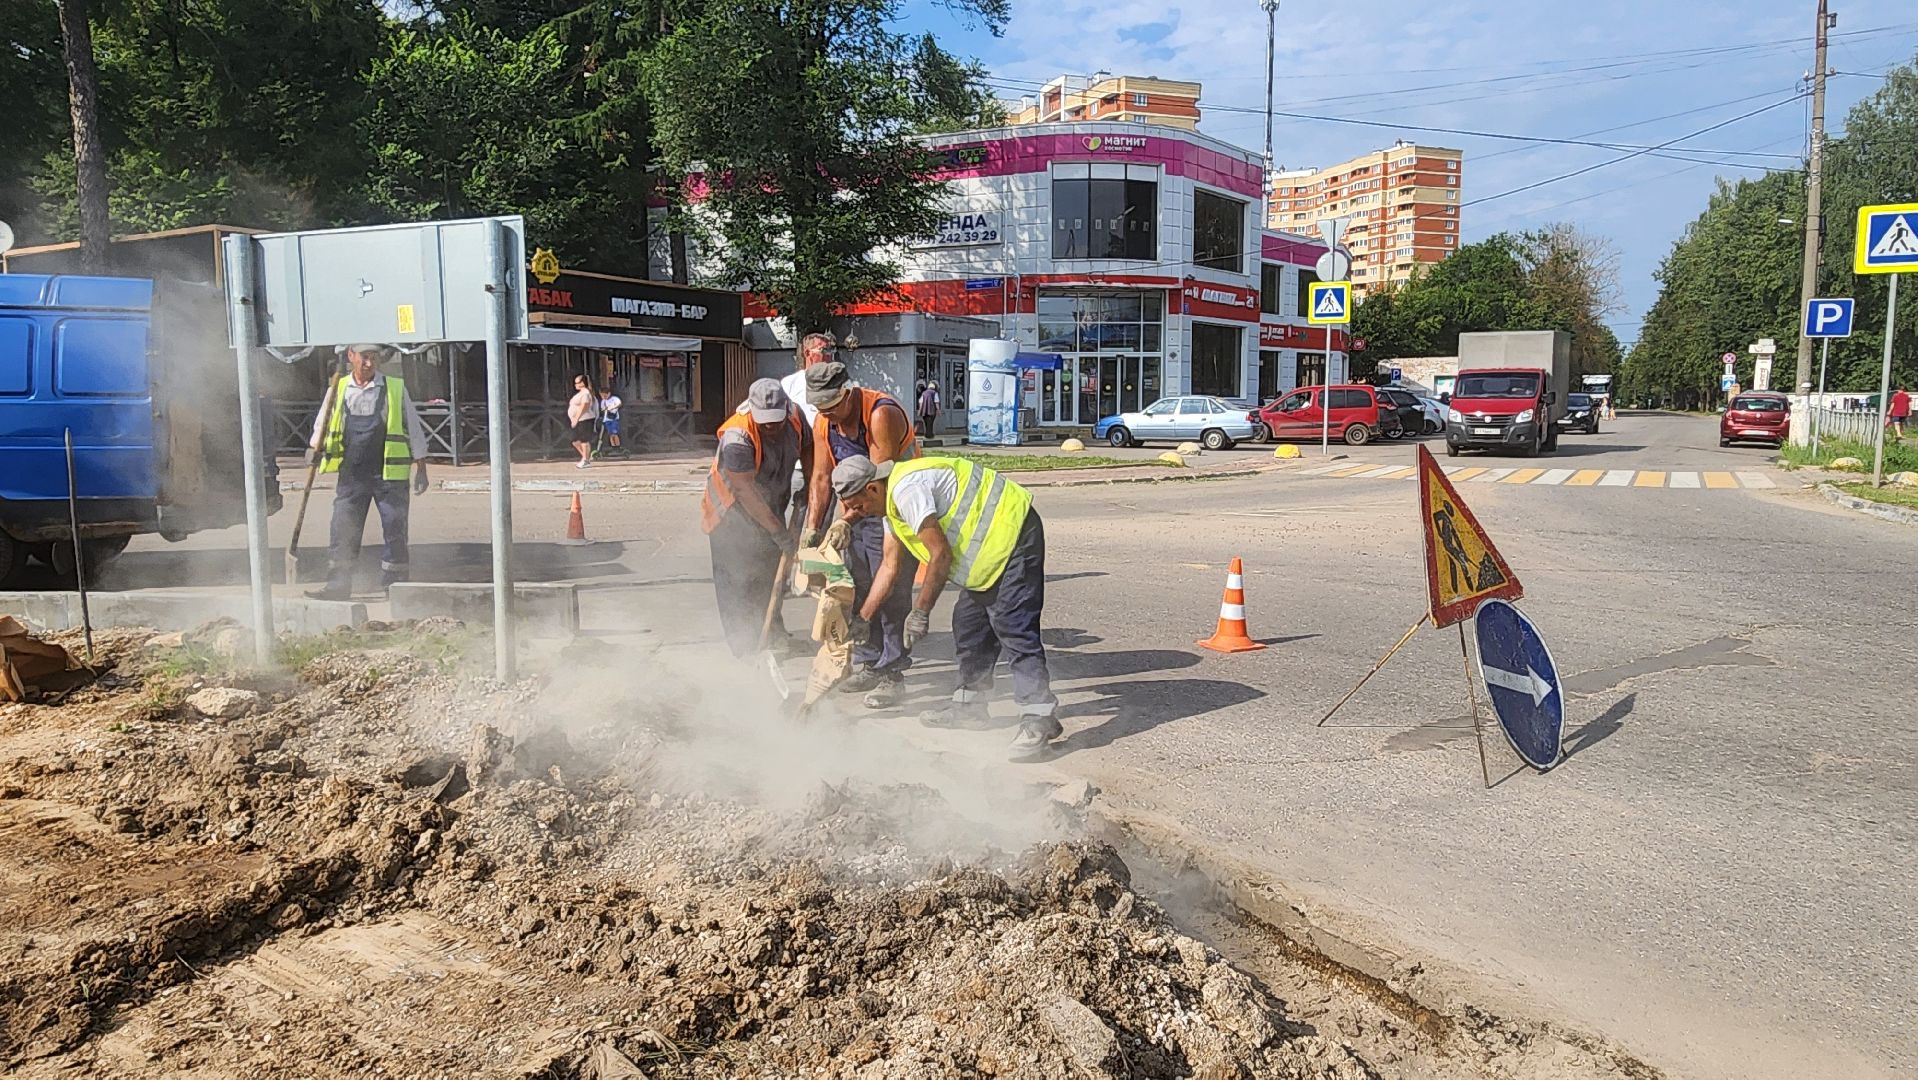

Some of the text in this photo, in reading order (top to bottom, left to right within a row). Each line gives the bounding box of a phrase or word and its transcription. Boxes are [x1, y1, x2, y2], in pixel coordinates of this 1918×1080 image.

[938, 214, 987, 232] ЕНДА
[938, 233, 961, 244] 242
[964, 231, 979, 242] 39
[981, 230, 997, 241] 29
[528, 287, 574, 308] АБАК
[611, 297, 708, 320] МАГАЗИН-БАР
[1815, 303, 1843, 333] P
[1392, 369, 1400, 380] P
